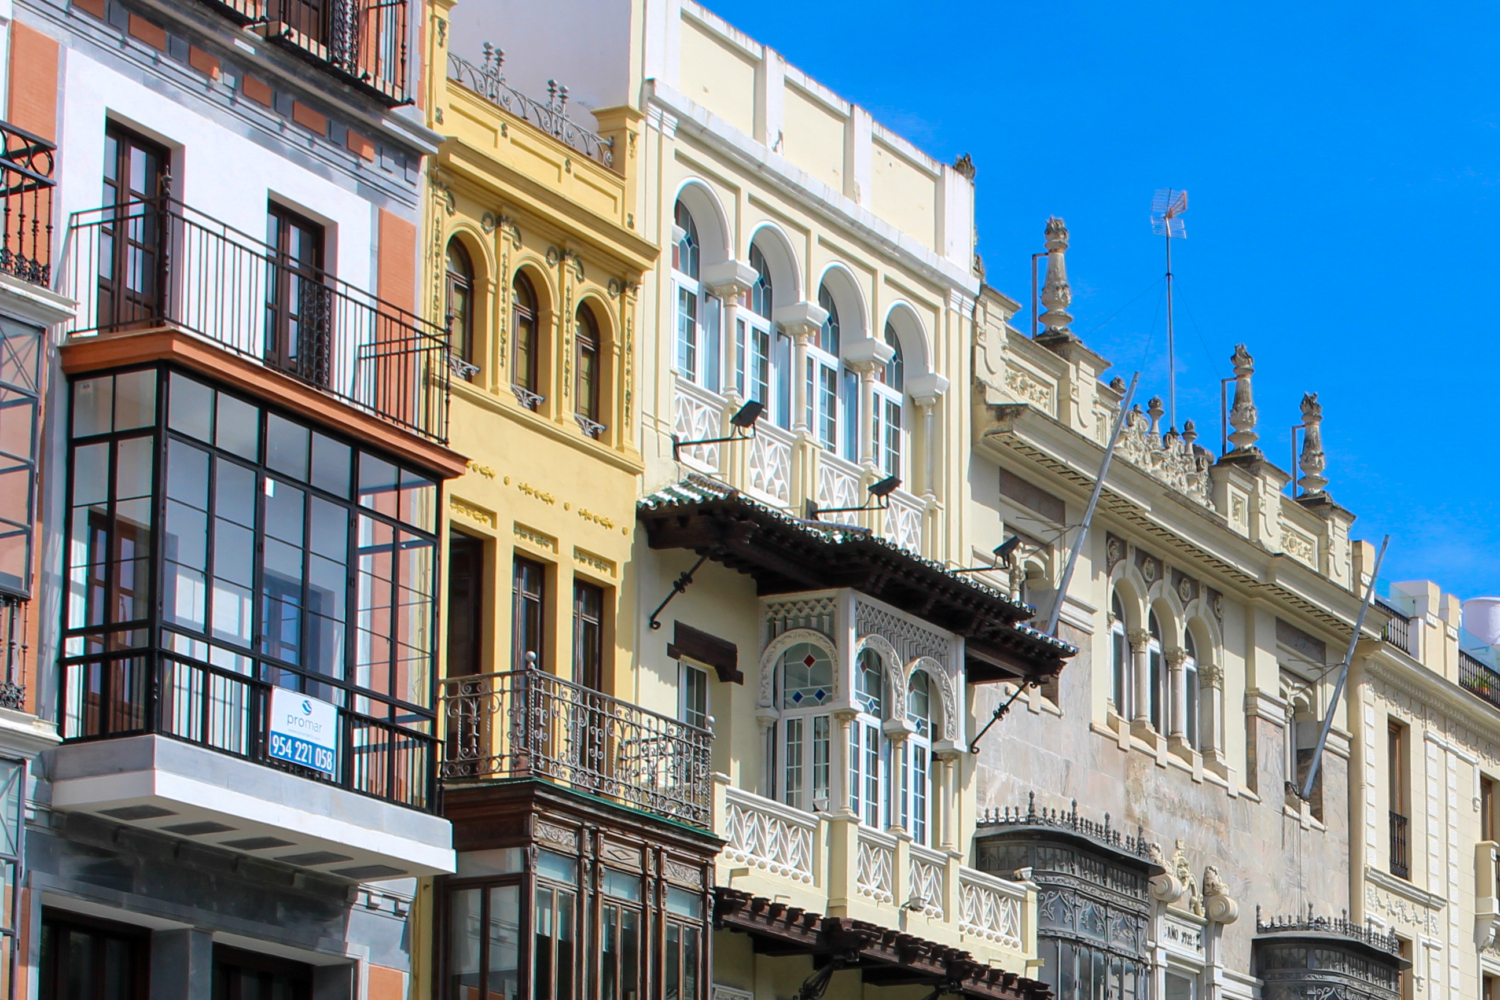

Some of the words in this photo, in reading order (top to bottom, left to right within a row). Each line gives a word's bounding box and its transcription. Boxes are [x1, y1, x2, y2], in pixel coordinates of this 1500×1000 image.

[287, 714, 323, 733] promar
[272, 734, 293, 758] 954
[294, 741, 312, 764] 221
[315, 747, 333, 770] 058
